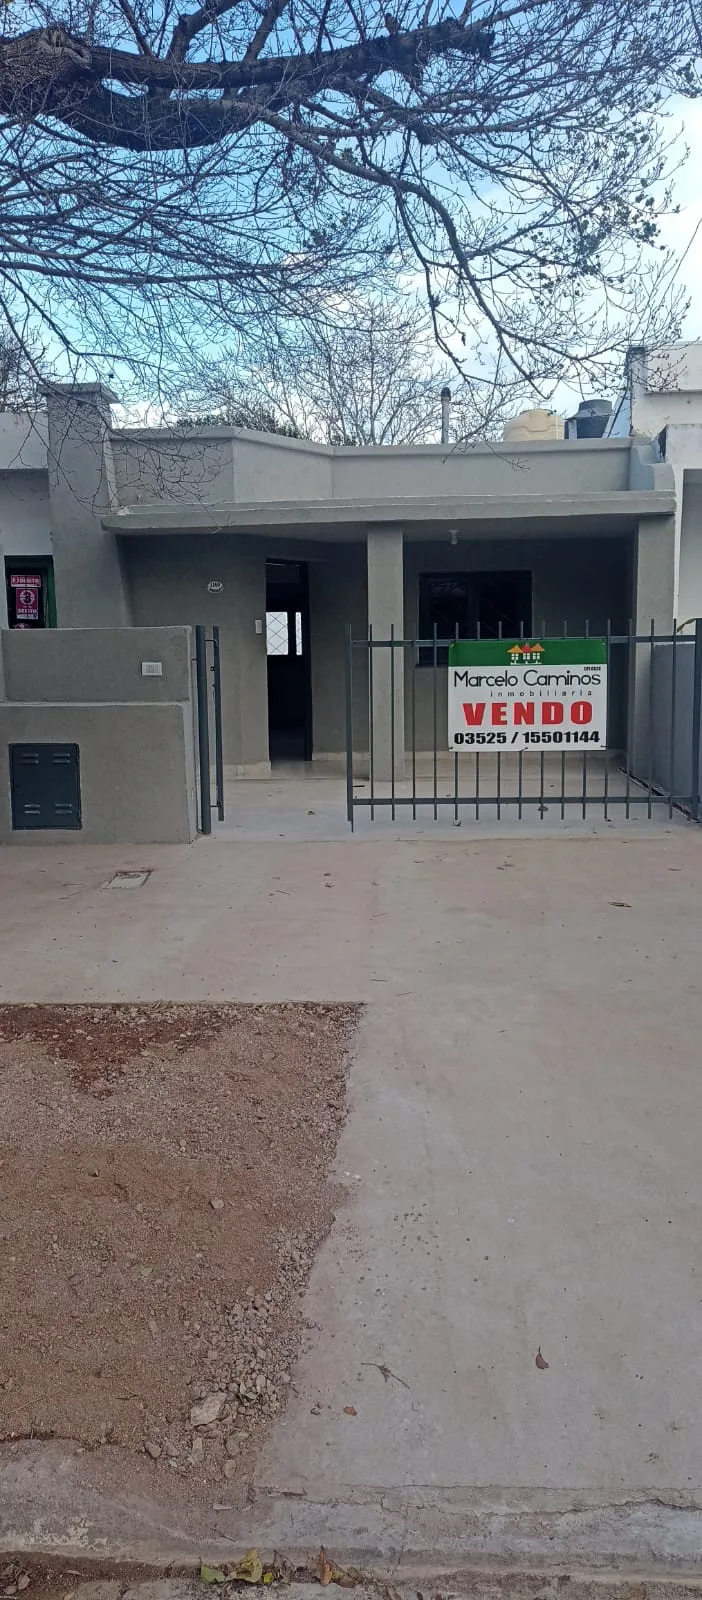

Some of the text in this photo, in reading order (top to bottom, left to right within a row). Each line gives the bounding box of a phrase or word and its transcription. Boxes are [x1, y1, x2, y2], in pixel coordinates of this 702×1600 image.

[454, 669, 601, 687] Marcelo Caminos
[490, 689, 593, 697] inmobiliaria
[462, 701, 593, 726] VENDO
[454, 731, 600, 745] 03525 / 15501144
